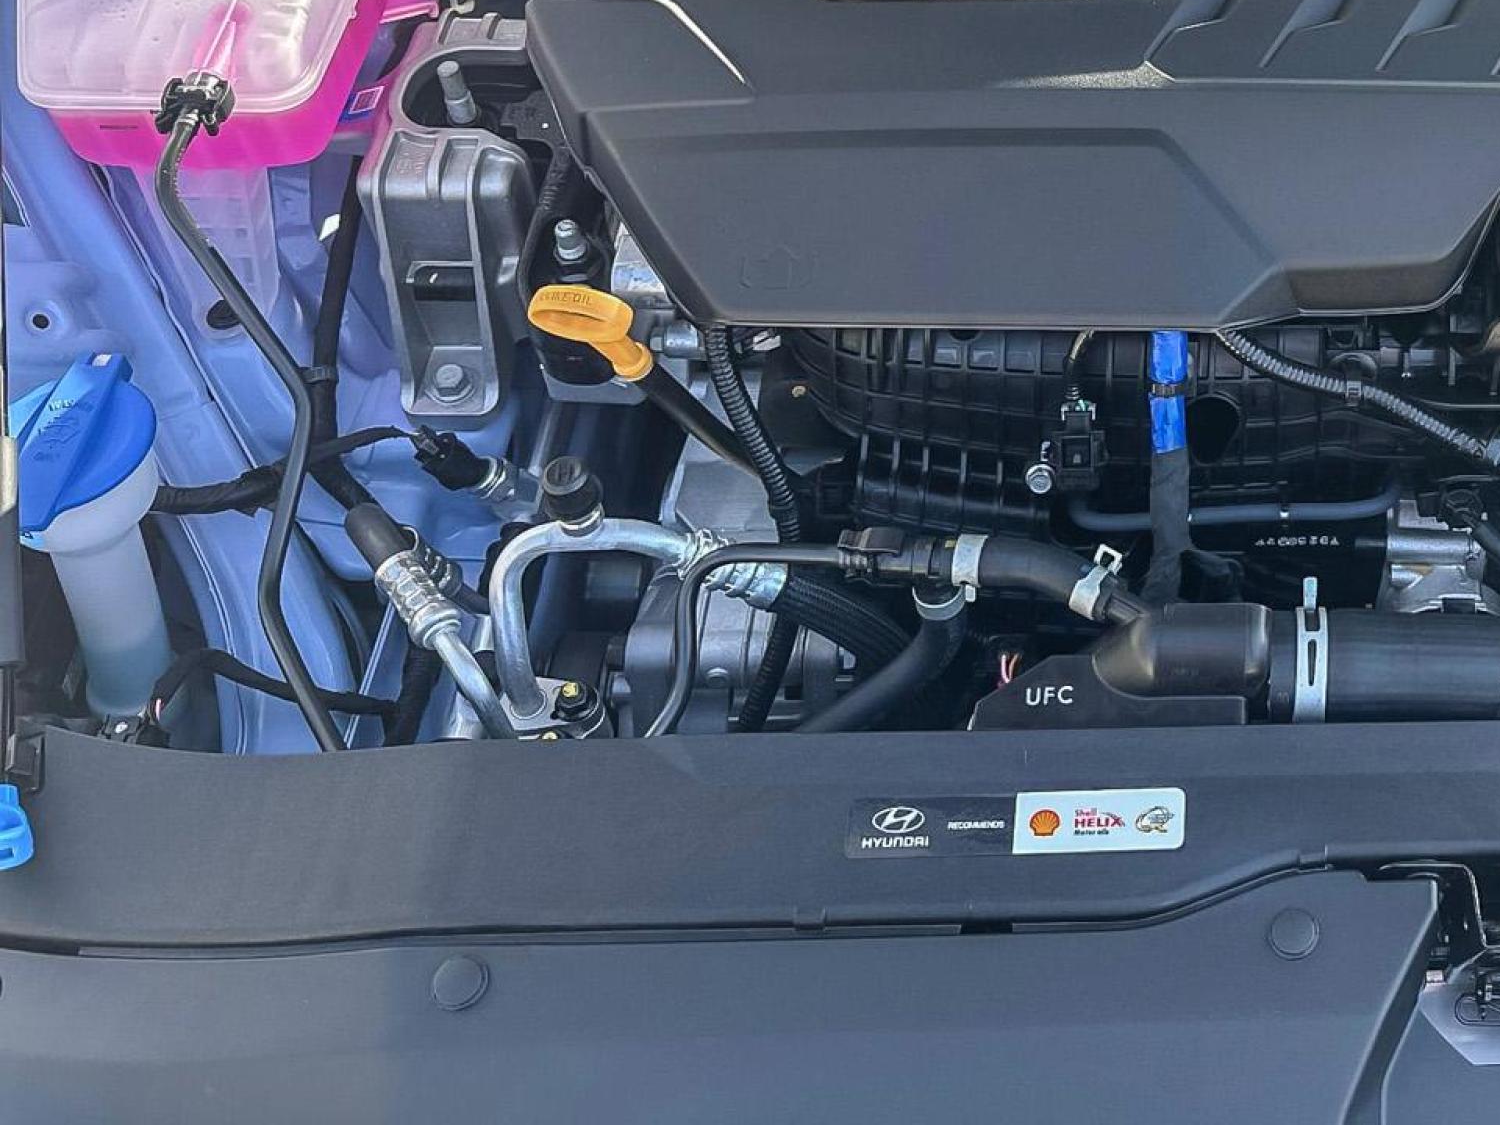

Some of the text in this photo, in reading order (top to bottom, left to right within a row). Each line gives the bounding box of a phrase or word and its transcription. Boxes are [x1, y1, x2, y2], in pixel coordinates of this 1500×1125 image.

[1025, 685, 1074, 706] UFC
[1074, 817, 1122, 828] HELIX
[861, 836, 929, 849] HYUNDAI
